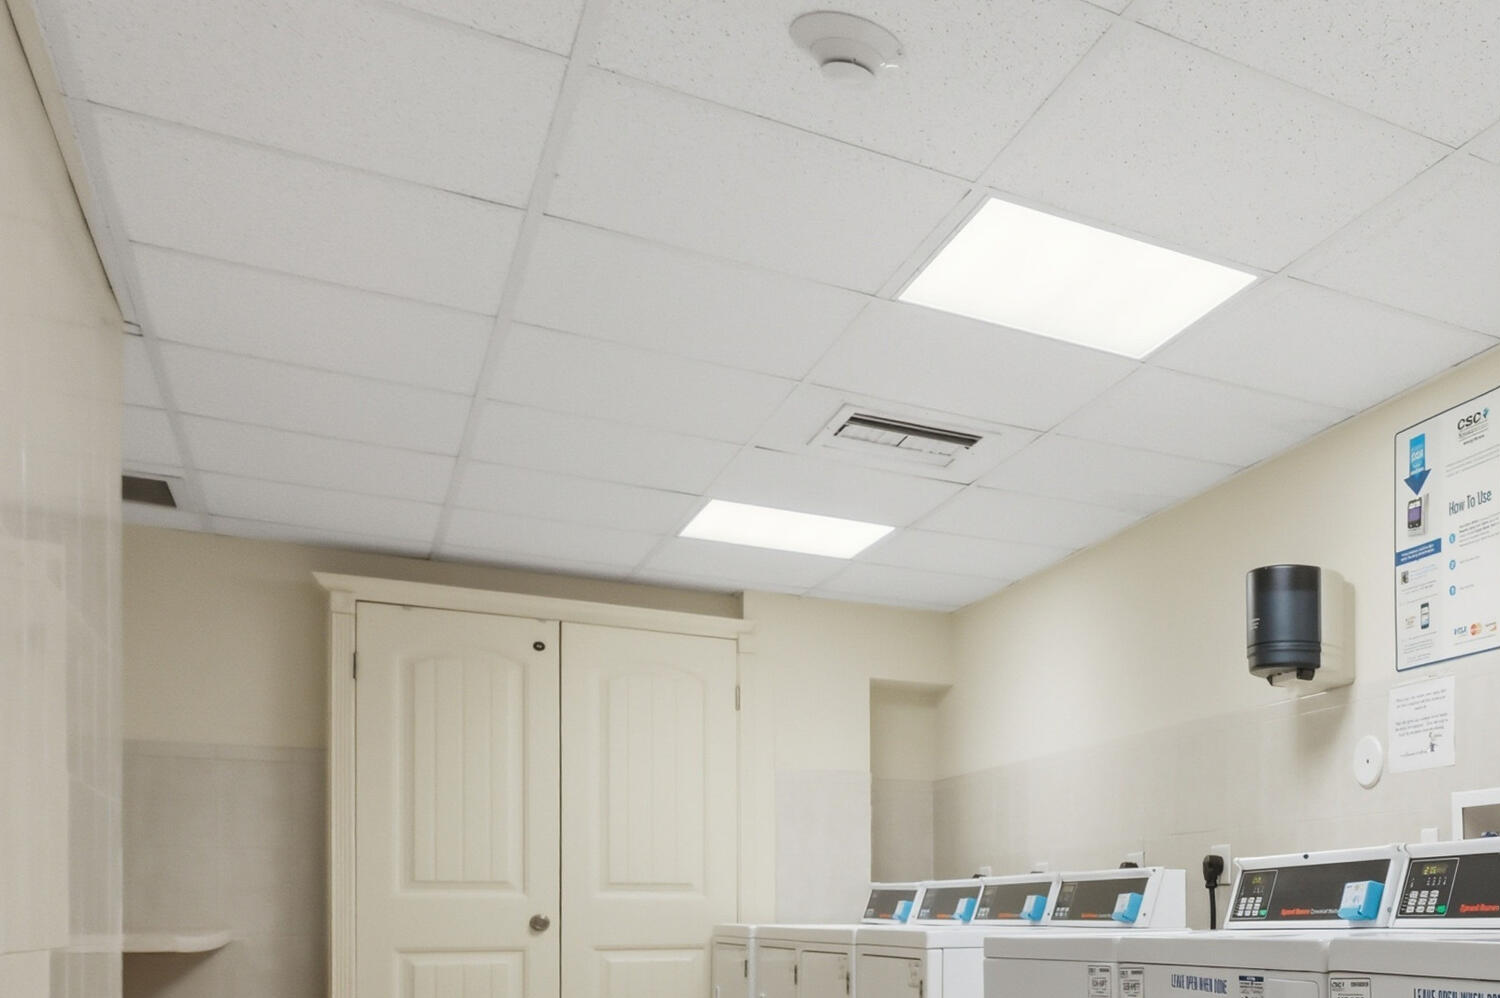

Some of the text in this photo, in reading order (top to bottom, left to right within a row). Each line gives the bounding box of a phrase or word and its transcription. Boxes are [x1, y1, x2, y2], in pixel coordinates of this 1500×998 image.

[1457, 412, 1481, 430] CSC
[1448, 490, 1492, 516] How To Use
